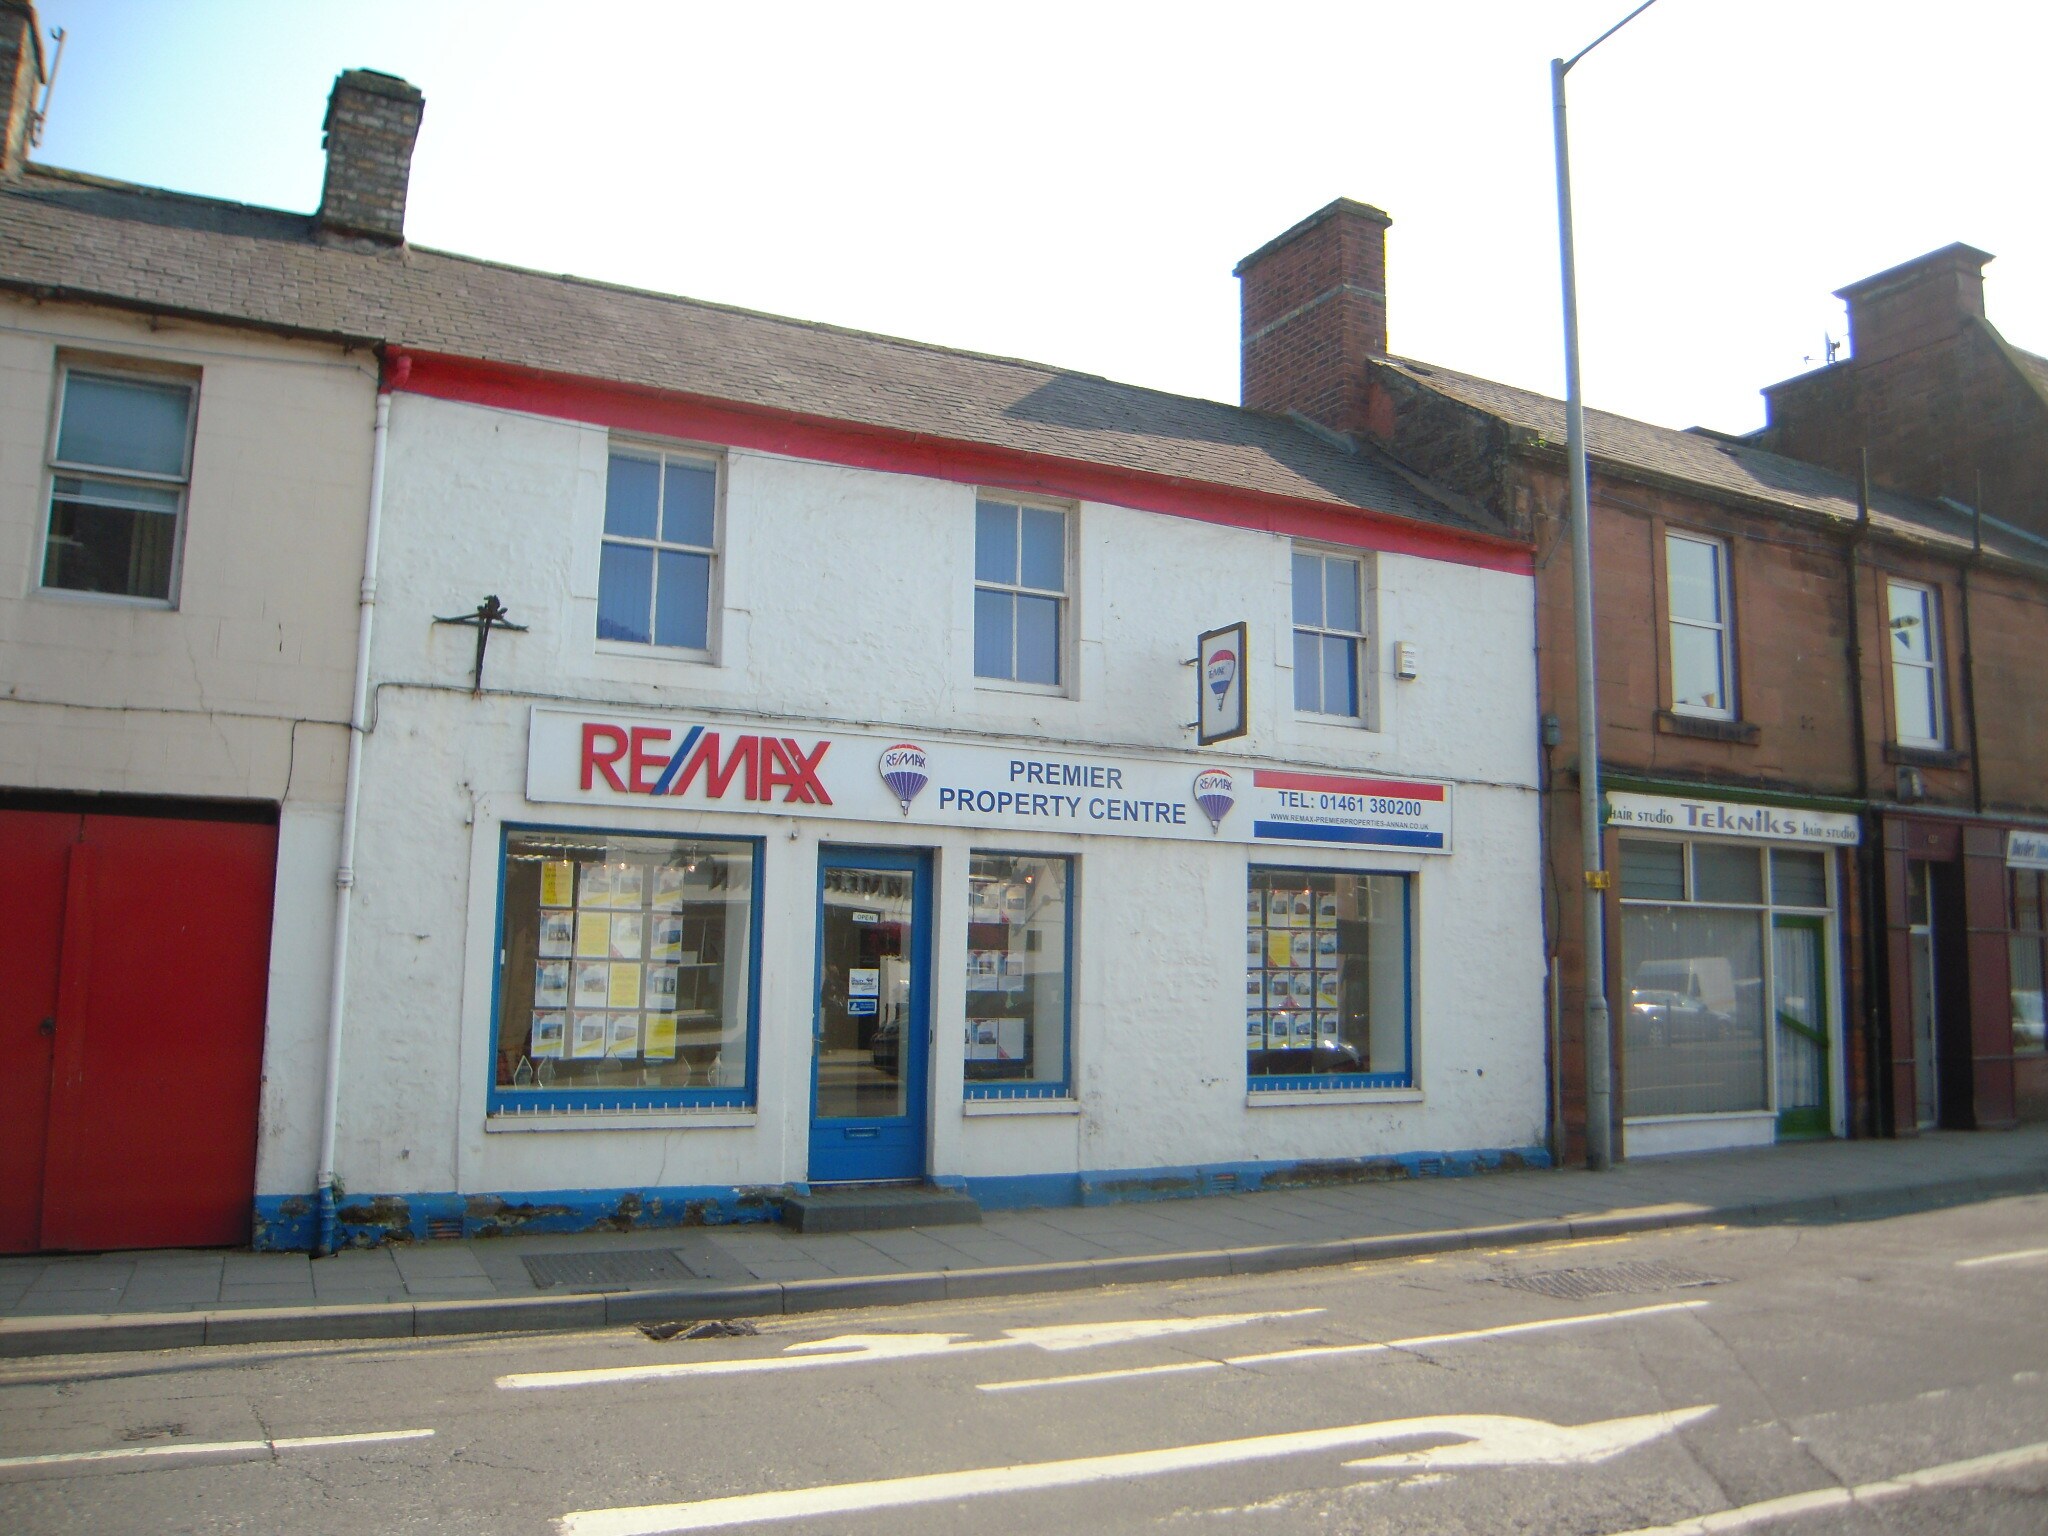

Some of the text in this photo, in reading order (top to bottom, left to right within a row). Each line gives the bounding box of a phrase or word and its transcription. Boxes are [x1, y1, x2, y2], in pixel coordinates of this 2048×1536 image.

[580, 722, 834, 806] RE/MAX
[885, 752, 926, 769] RE/MAX
[1009, 760, 1123, 790] PREMIER
[1199, 776, 1233, 791] RE/MAX
[938, 787, 1187, 825] PROPERTY CENTRE
[1278, 791, 1422, 817] TEL: 01461 380200
[1680, 803, 1797, 835] Tekniks
